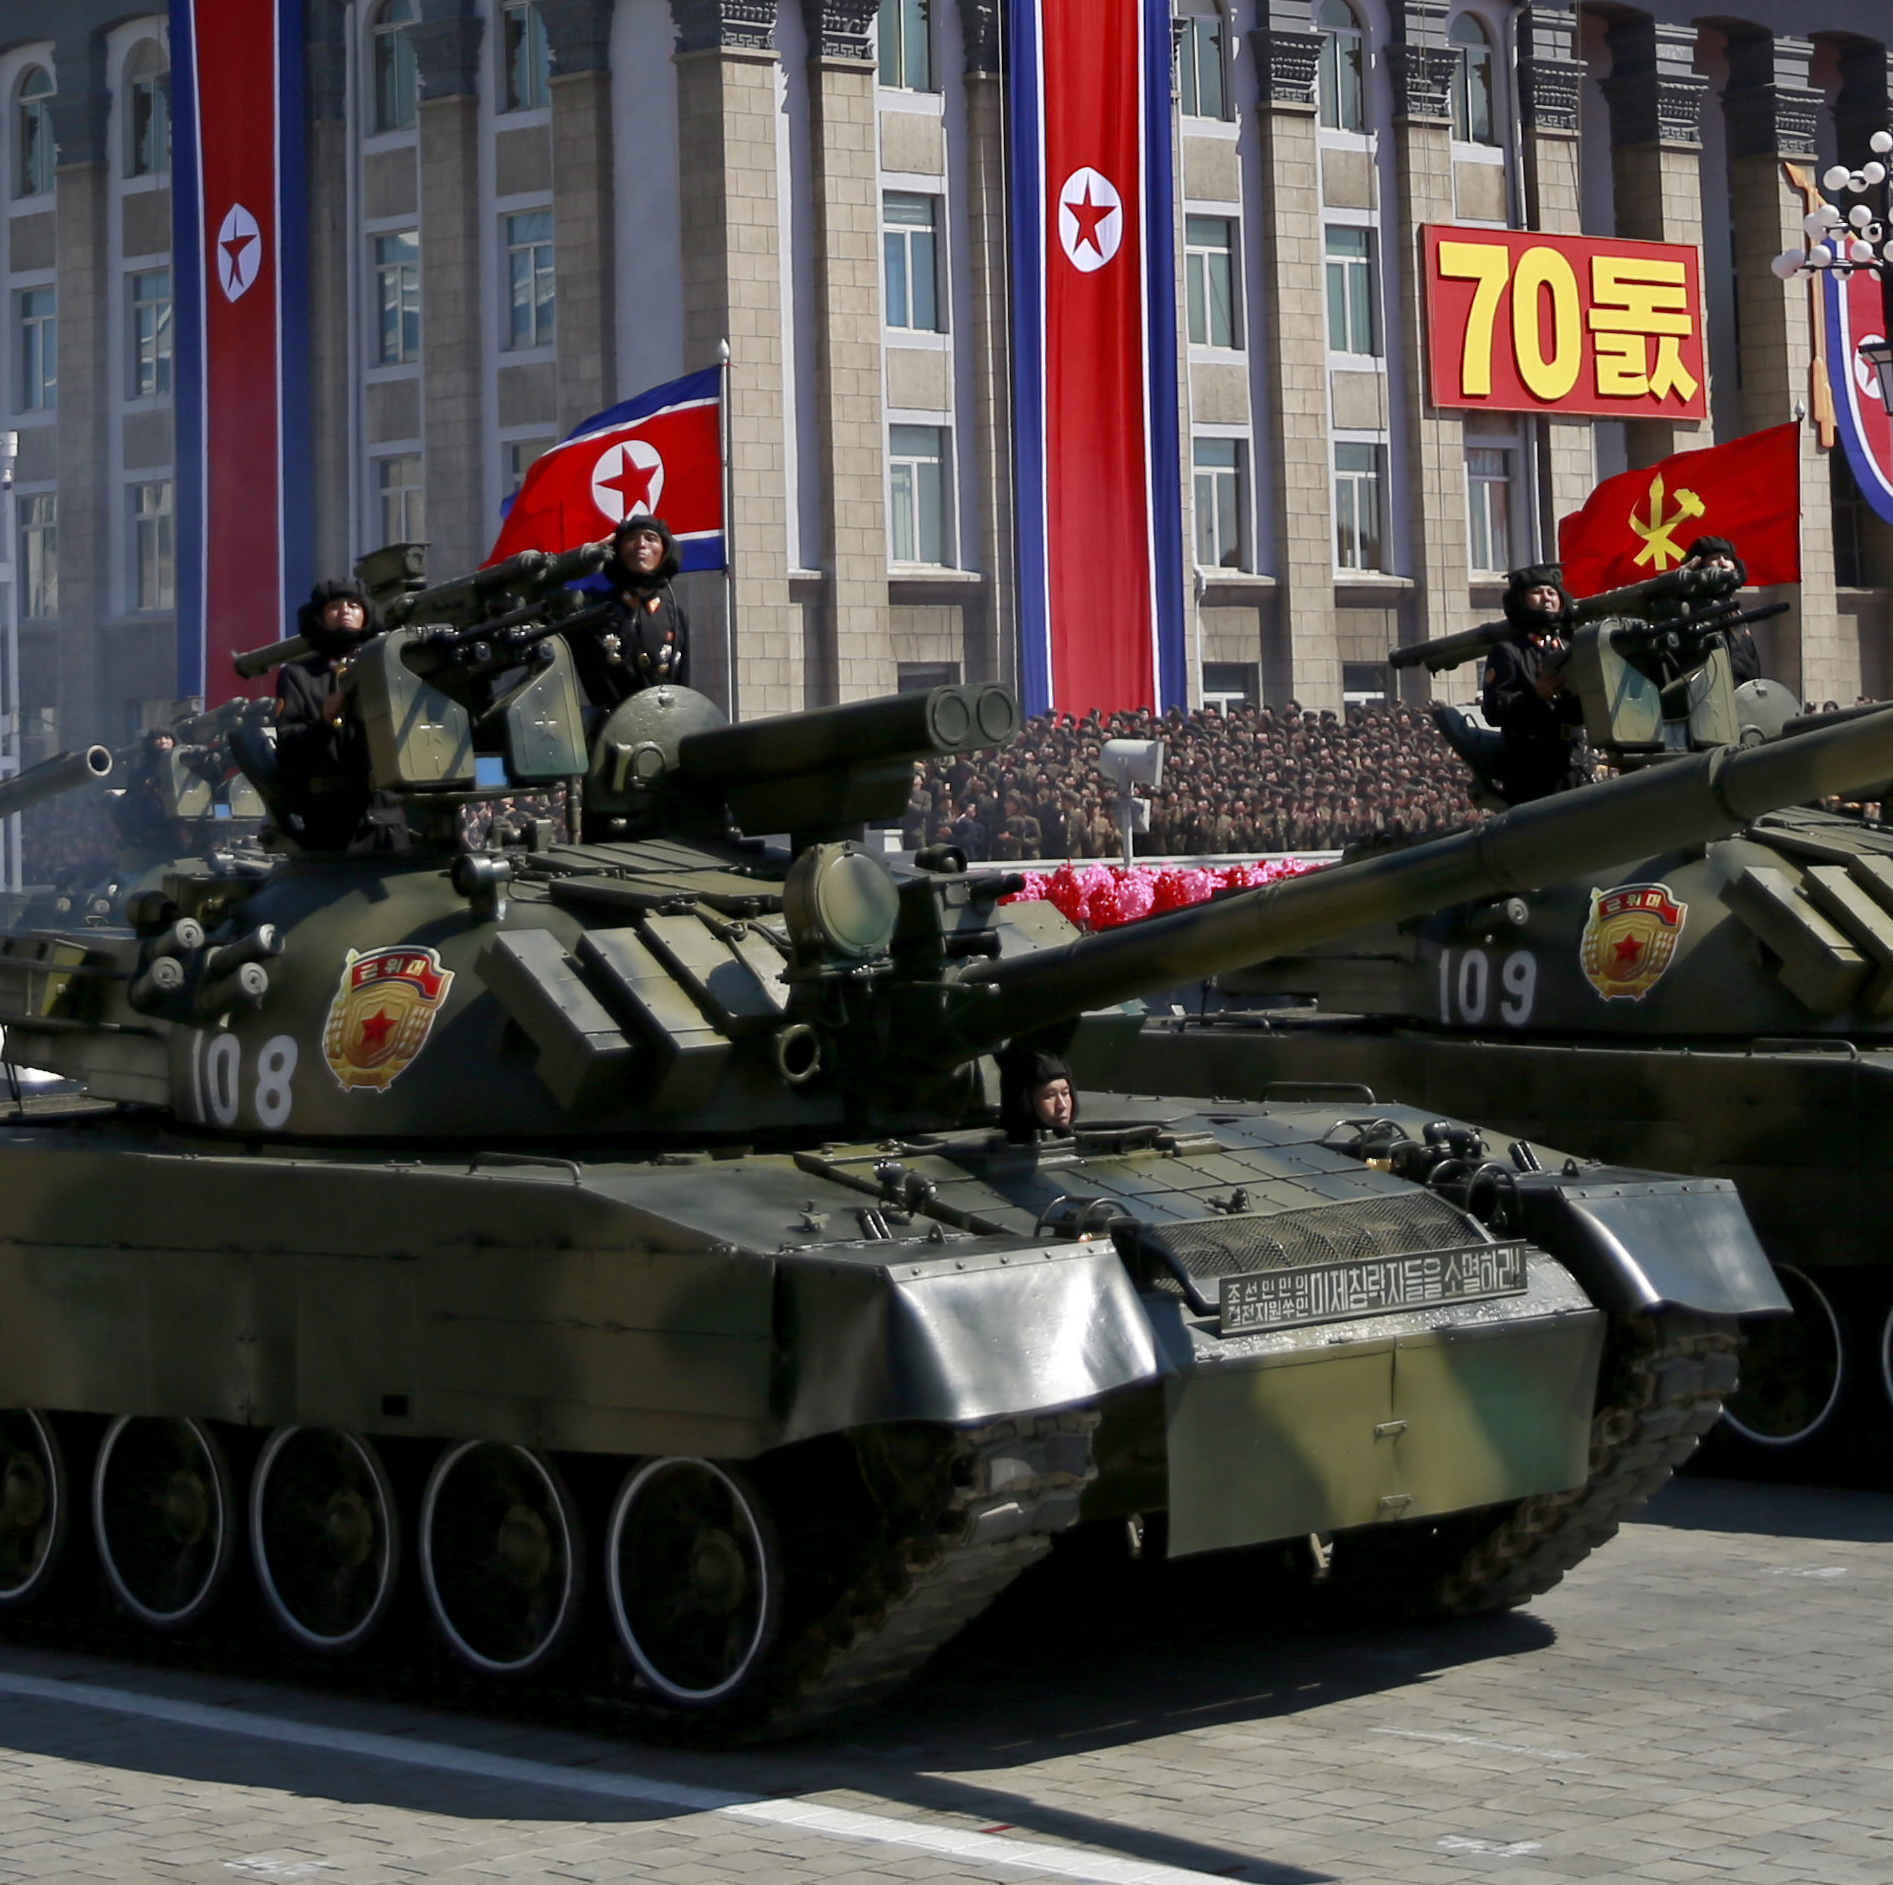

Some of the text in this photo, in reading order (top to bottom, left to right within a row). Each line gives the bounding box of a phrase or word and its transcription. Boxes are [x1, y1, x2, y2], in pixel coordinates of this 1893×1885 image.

[360, 957, 427, 981] 근위대
[1438, 948, 1538, 1026] 109
[192, 1028, 299, 1128] 108
[1227, 1274, 1309, 1304] 조선인민의
